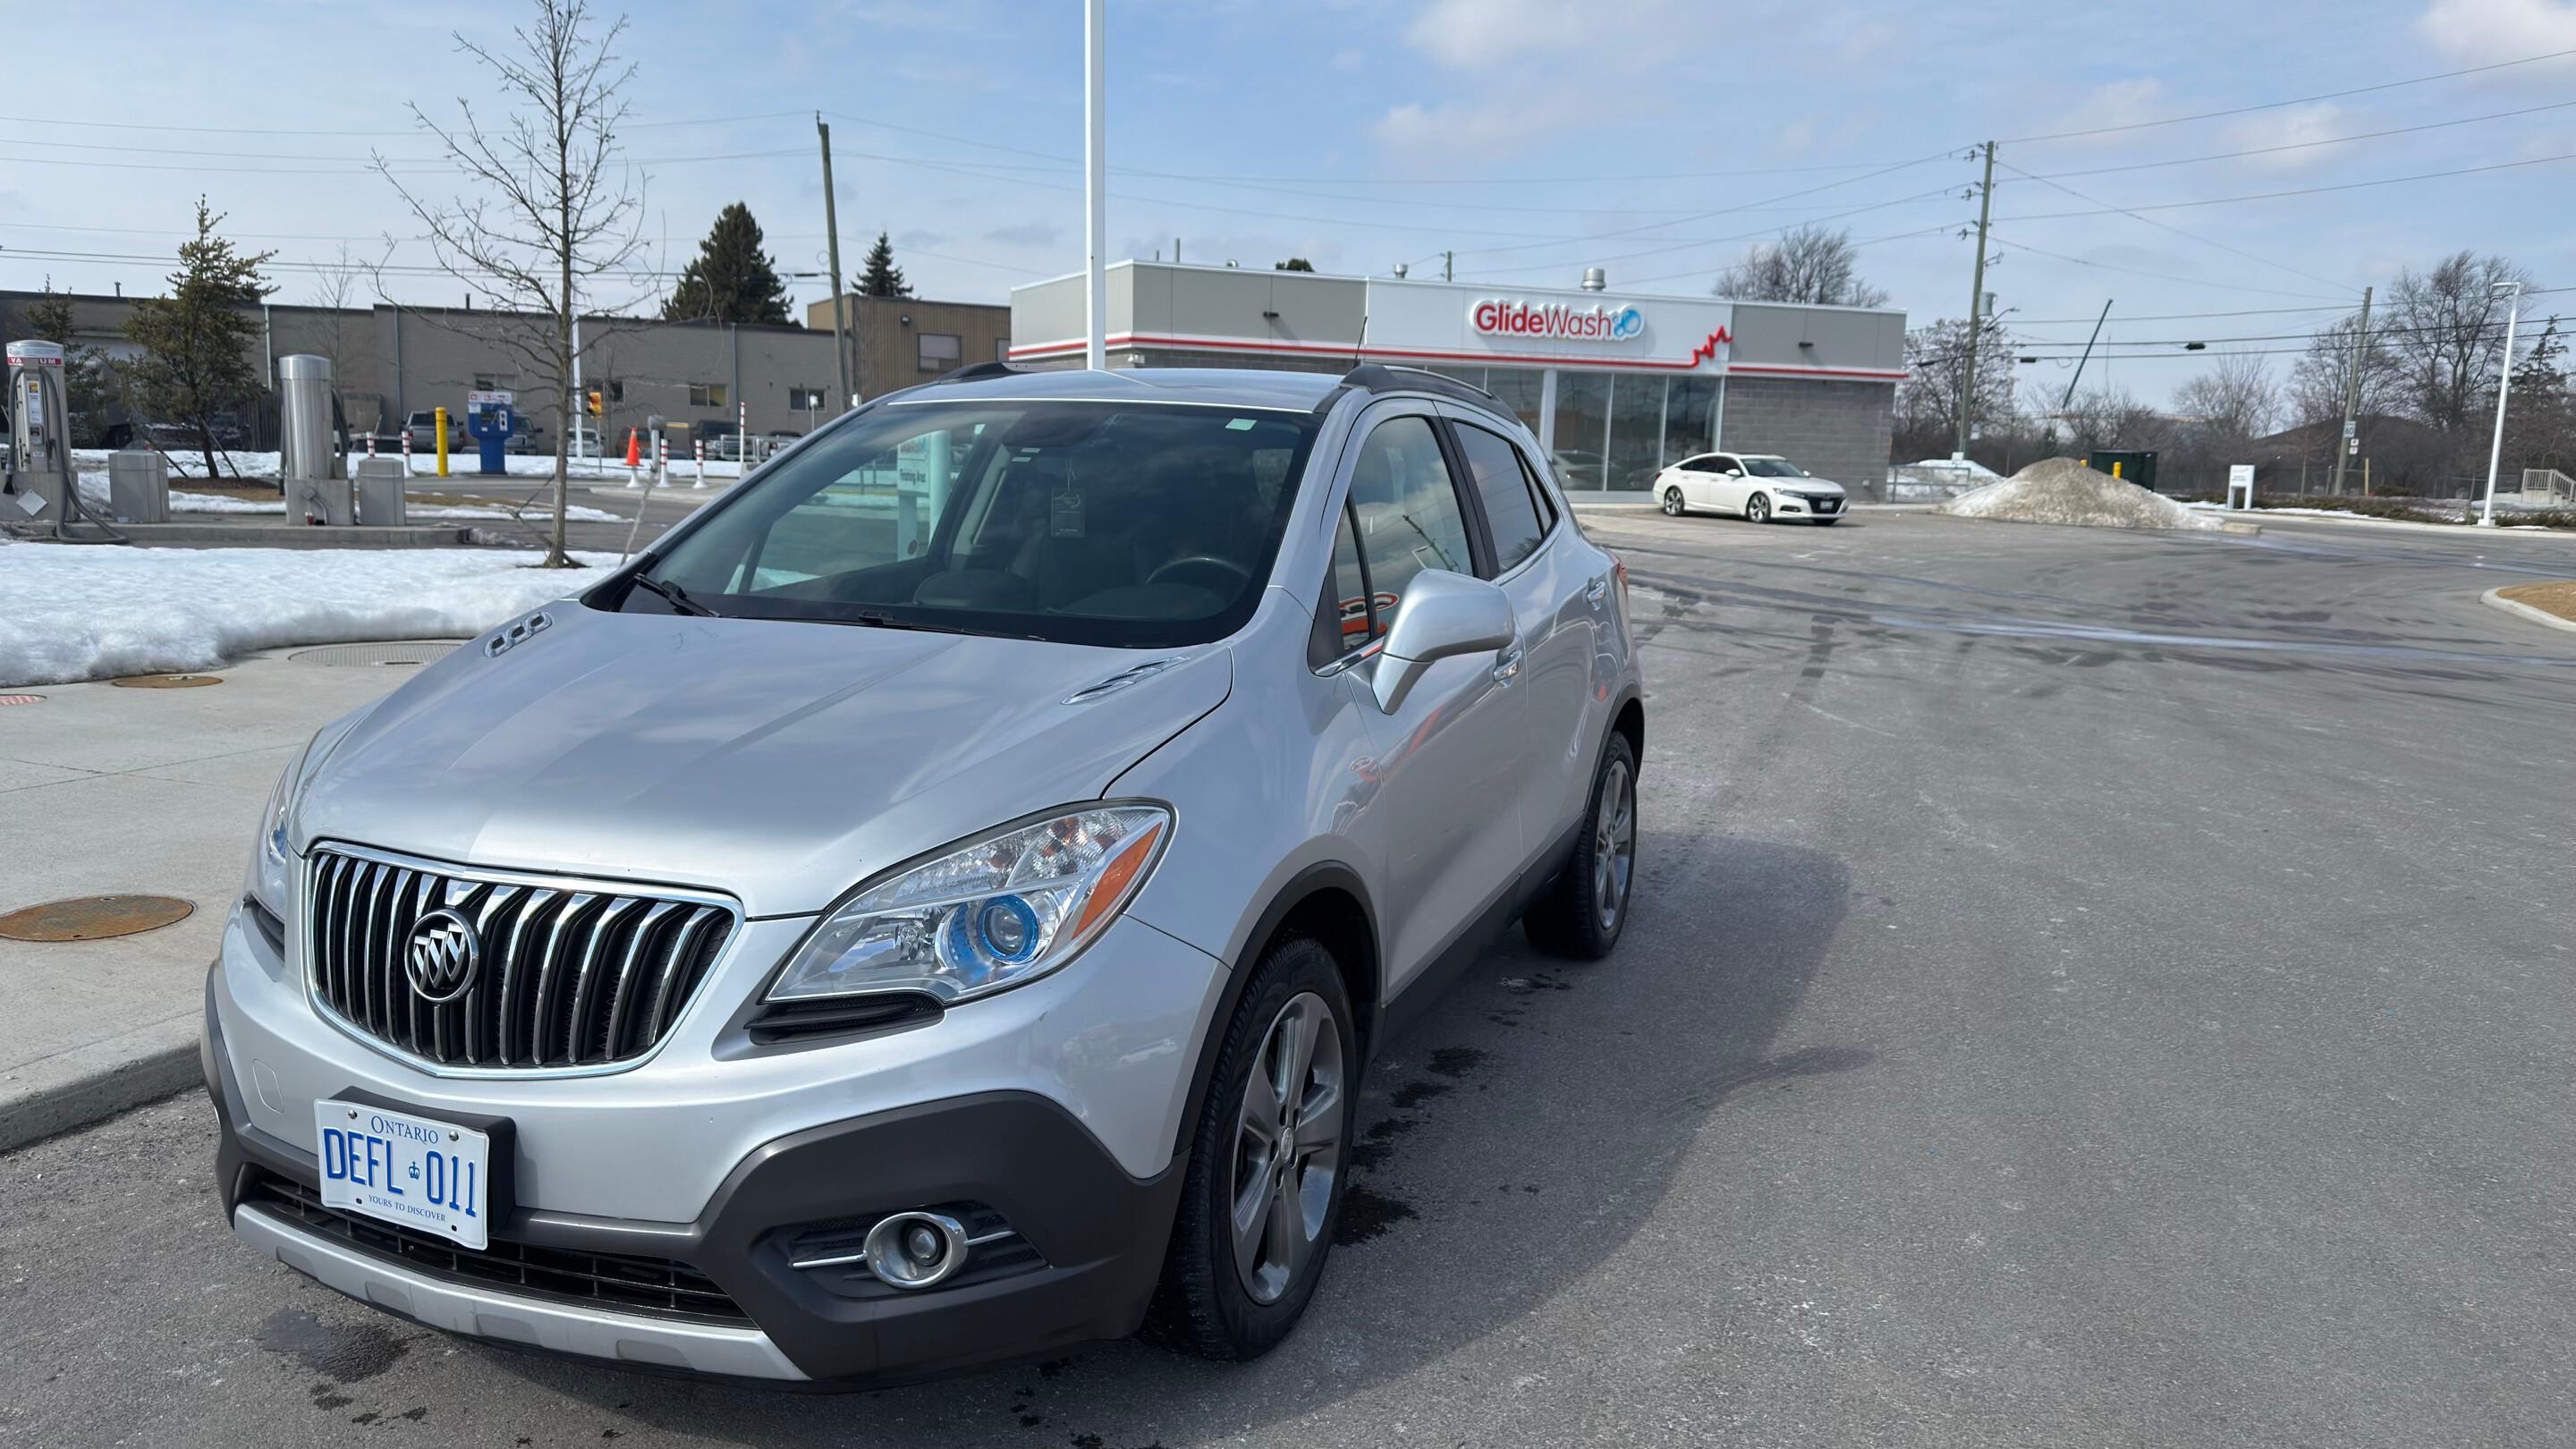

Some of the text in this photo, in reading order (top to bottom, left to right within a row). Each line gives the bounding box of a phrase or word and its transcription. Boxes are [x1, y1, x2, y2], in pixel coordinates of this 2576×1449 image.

[1475, 302, 1612, 337] GlideWash
[370, 1115, 439, 1145] ONTARIO
[323, 1127, 477, 1217] DEFL 011
[369, 1194, 446, 1222] YOURS TO DISCOVER
